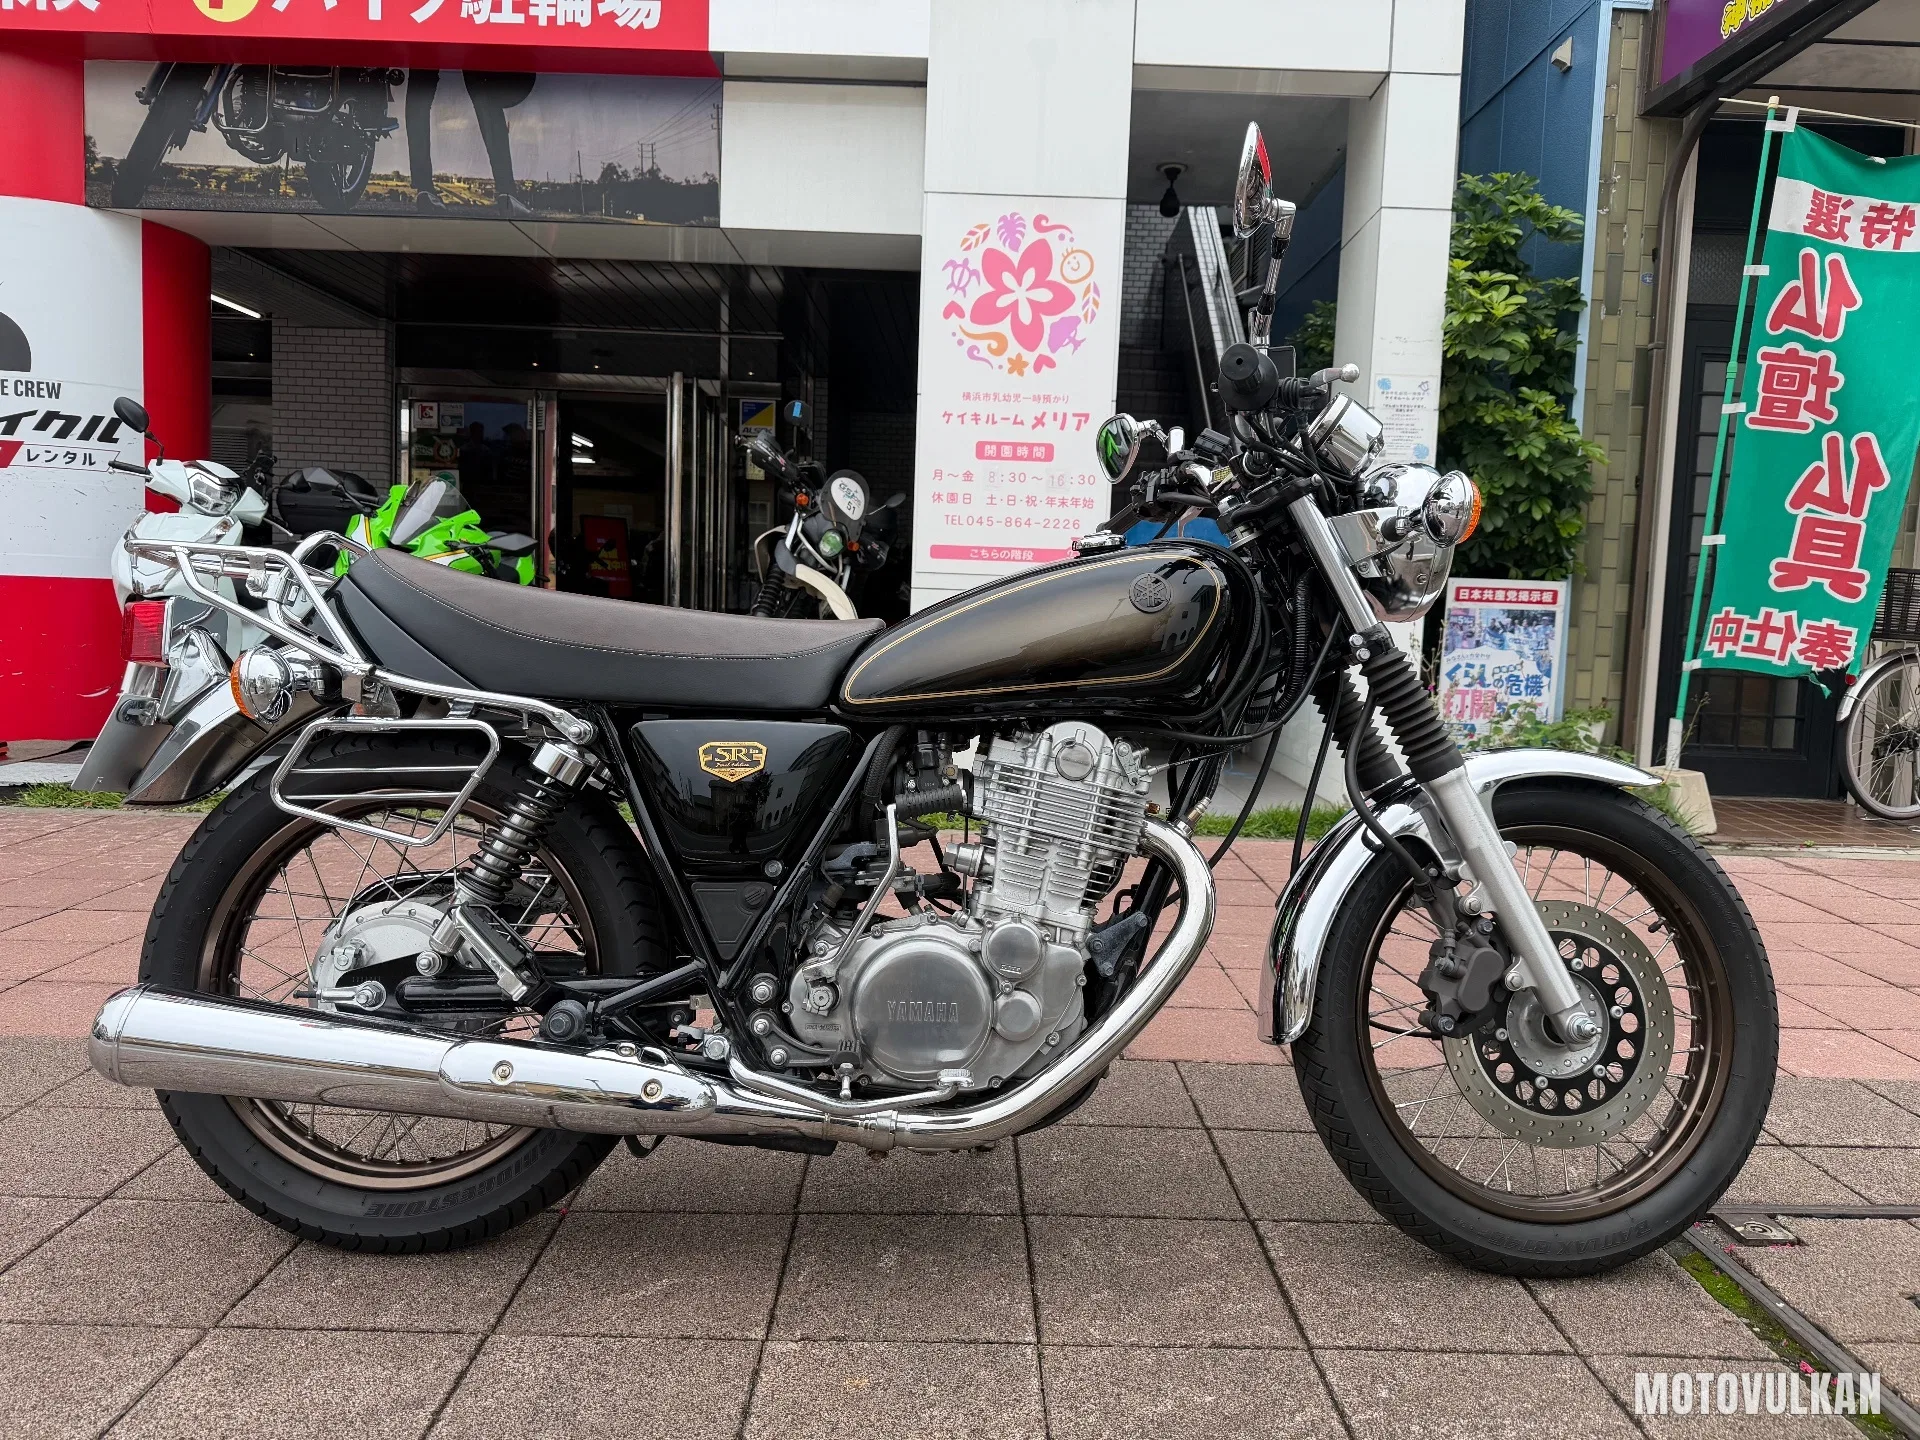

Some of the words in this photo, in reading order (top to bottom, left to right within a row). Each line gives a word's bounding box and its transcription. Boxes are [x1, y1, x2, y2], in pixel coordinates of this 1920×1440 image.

[13, 379, 62, 400] CREW
[961, 391, 1070, 405] 横浜市乳幼児一時預かり
[942, 410, 1025, 426] ケイキルーム
[1031, 411, 1091, 432] メリア
[26, 448, 97, 467] レンタル
[984, 444, 1046, 459] 開園時間
[931, 491, 973, 505] 休園日
[969, 549, 1035, 561] こちらの階段
[1459, 588, 1554, 604] 日本共産党掲示板
[714, 747, 752, 762] SR
[887, 1000, 959, 1022] YAMAHA
